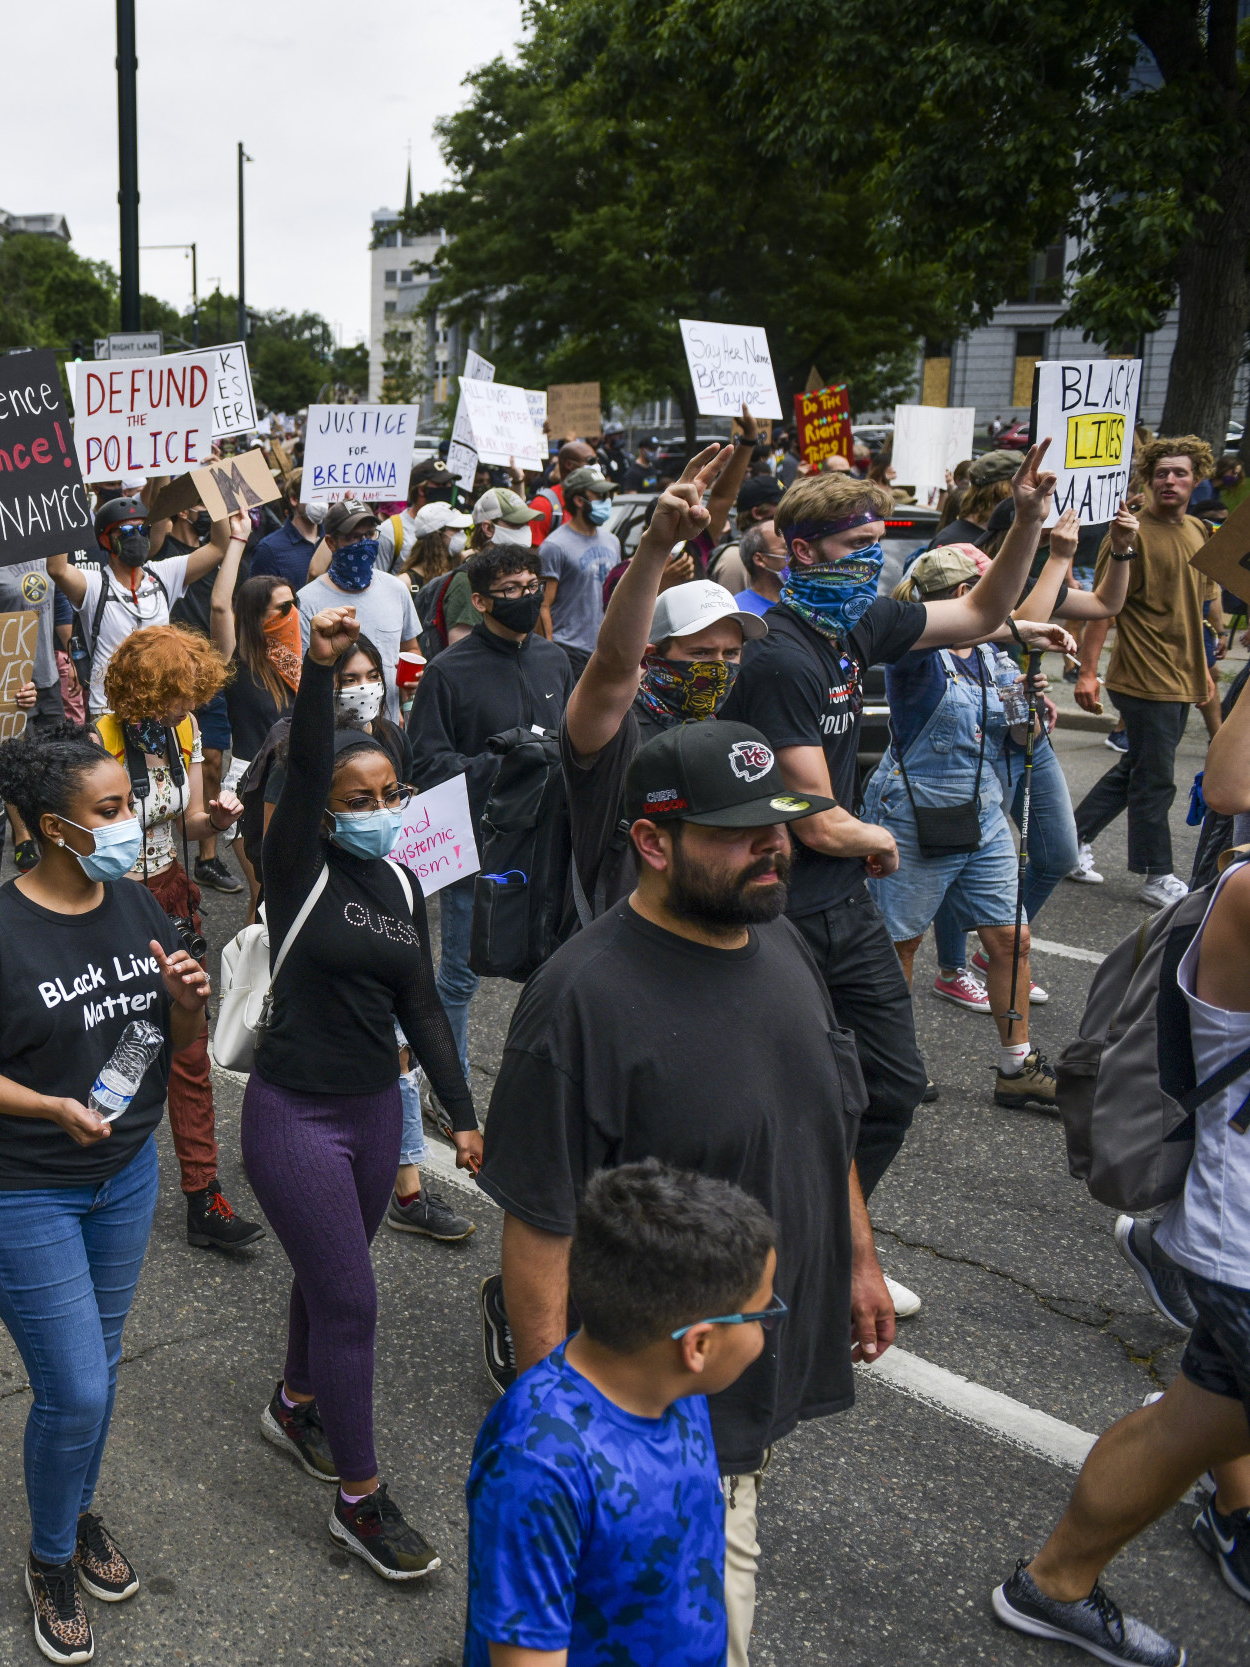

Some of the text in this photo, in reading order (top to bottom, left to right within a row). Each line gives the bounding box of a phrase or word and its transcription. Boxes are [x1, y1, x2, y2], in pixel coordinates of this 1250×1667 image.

[111, 341, 158, 351] RIGHT LANE
[689, 327, 721, 368] Say
[86, 365, 207, 416] DEFUND
[464, 381, 483, 399] ALL
[693, 364, 763, 388] Breonna
[1062, 364, 1134, 411] BLACK
[126, 413, 148, 427] THE
[319, 411, 408, 435] JUSTICE
[86, 429, 199, 475] POLICE
[349, 446, 369, 456] FOR
[1074, 419, 1125, 460] LIVES
[313, 461, 397, 487] BREONNA
[74, 549, 88, 561] BE
[742, 747, 770, 767] KC
[646, 788, 678, 804] CHIEFS
[399, 806, 431, 840] nd
[1021, 793, 1031, 839] TRAVERSE
[411, 844, 462, 878] ism!
[344, 903, 421, 948] GUESS
[113, 953, 160, 982] Live
[83, 990, 158, 1031] Matter
